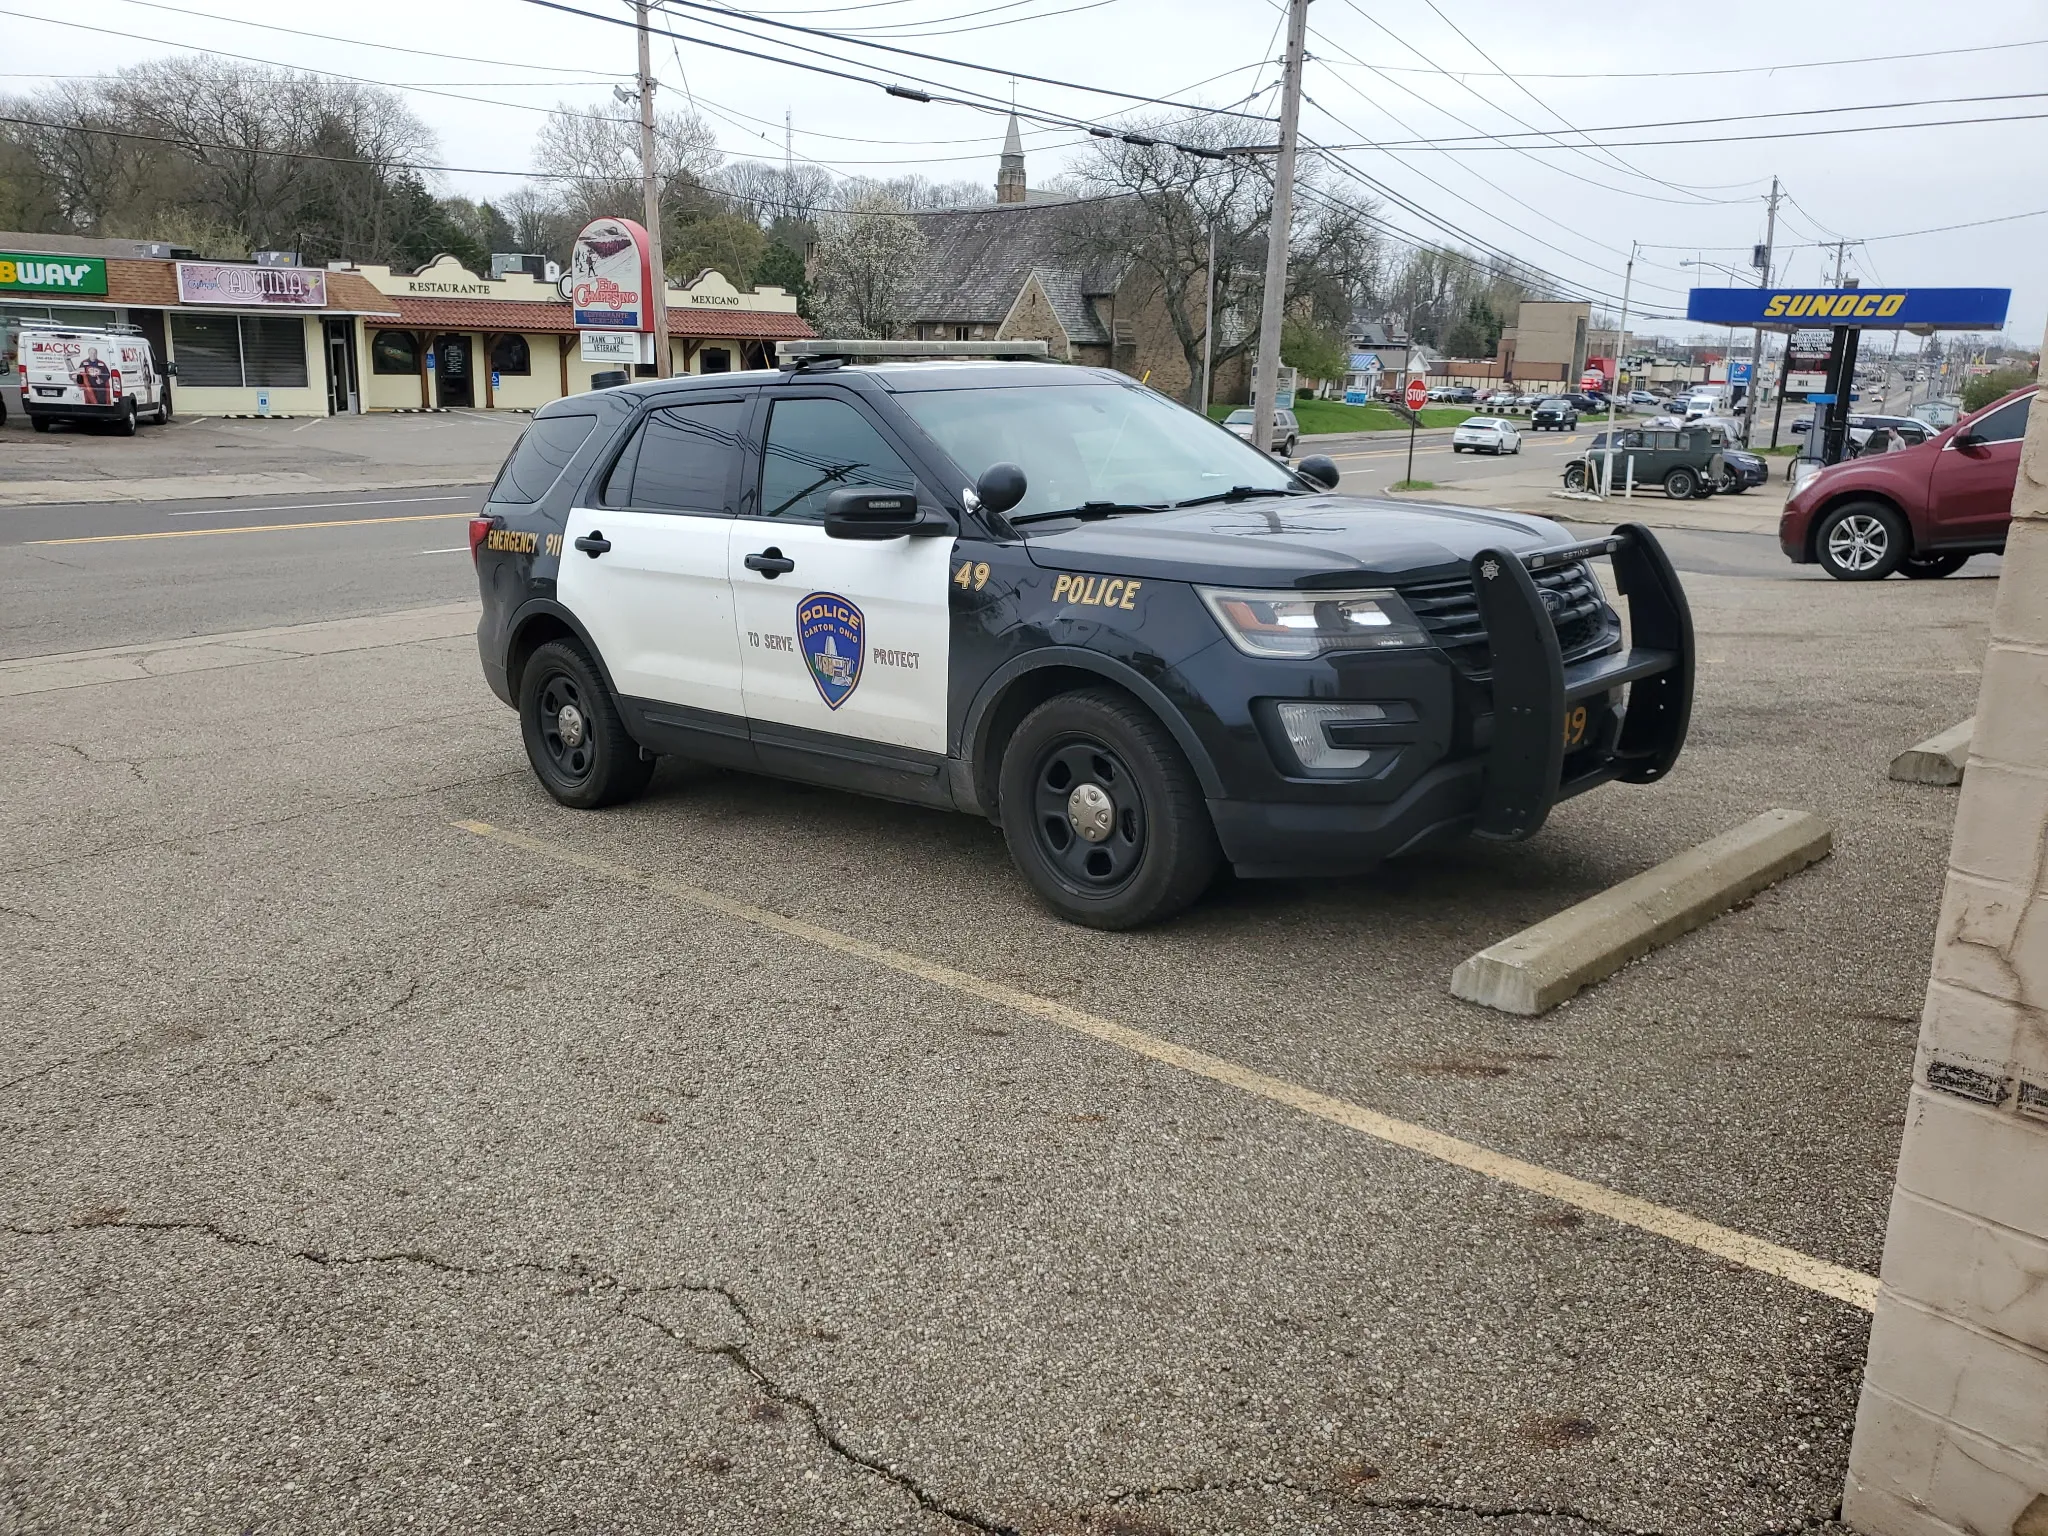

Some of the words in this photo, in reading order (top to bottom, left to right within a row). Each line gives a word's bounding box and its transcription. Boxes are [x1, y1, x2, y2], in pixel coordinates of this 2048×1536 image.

[217, 269, 303, 300] CANTINA
[409, 282, 491, 294] RESTAURANTE
[596, 278, 619, 292] EL
[691, 295, 739, 306] MEXICANO
[1763, 295, 1906, 317] SUNOCO
[588, 335, 606, 344] THANK
[613, 336, 625, 345] YOU
[593, 344, 621, 353] VETERANS
[1407, 389, 1426, 402] STOP
[488, 530, 539, 553] EMERGENCY
[545, 533, 563, 557] 911
[1562, 548, 1590, 559] SETINA
[954, 561, 991, 592] 49
[1051, 574, 1142, 610] POLICE
[801, 604, 860, 631] POLICE
[748, 631, 760, 648] TO
[764, 633, 794, 653] SERVE
[804, 623, 837, 638] CANTON,
[839, 626, 858, 644] OHIO
[873, 647, 920, 670] PROTECT
